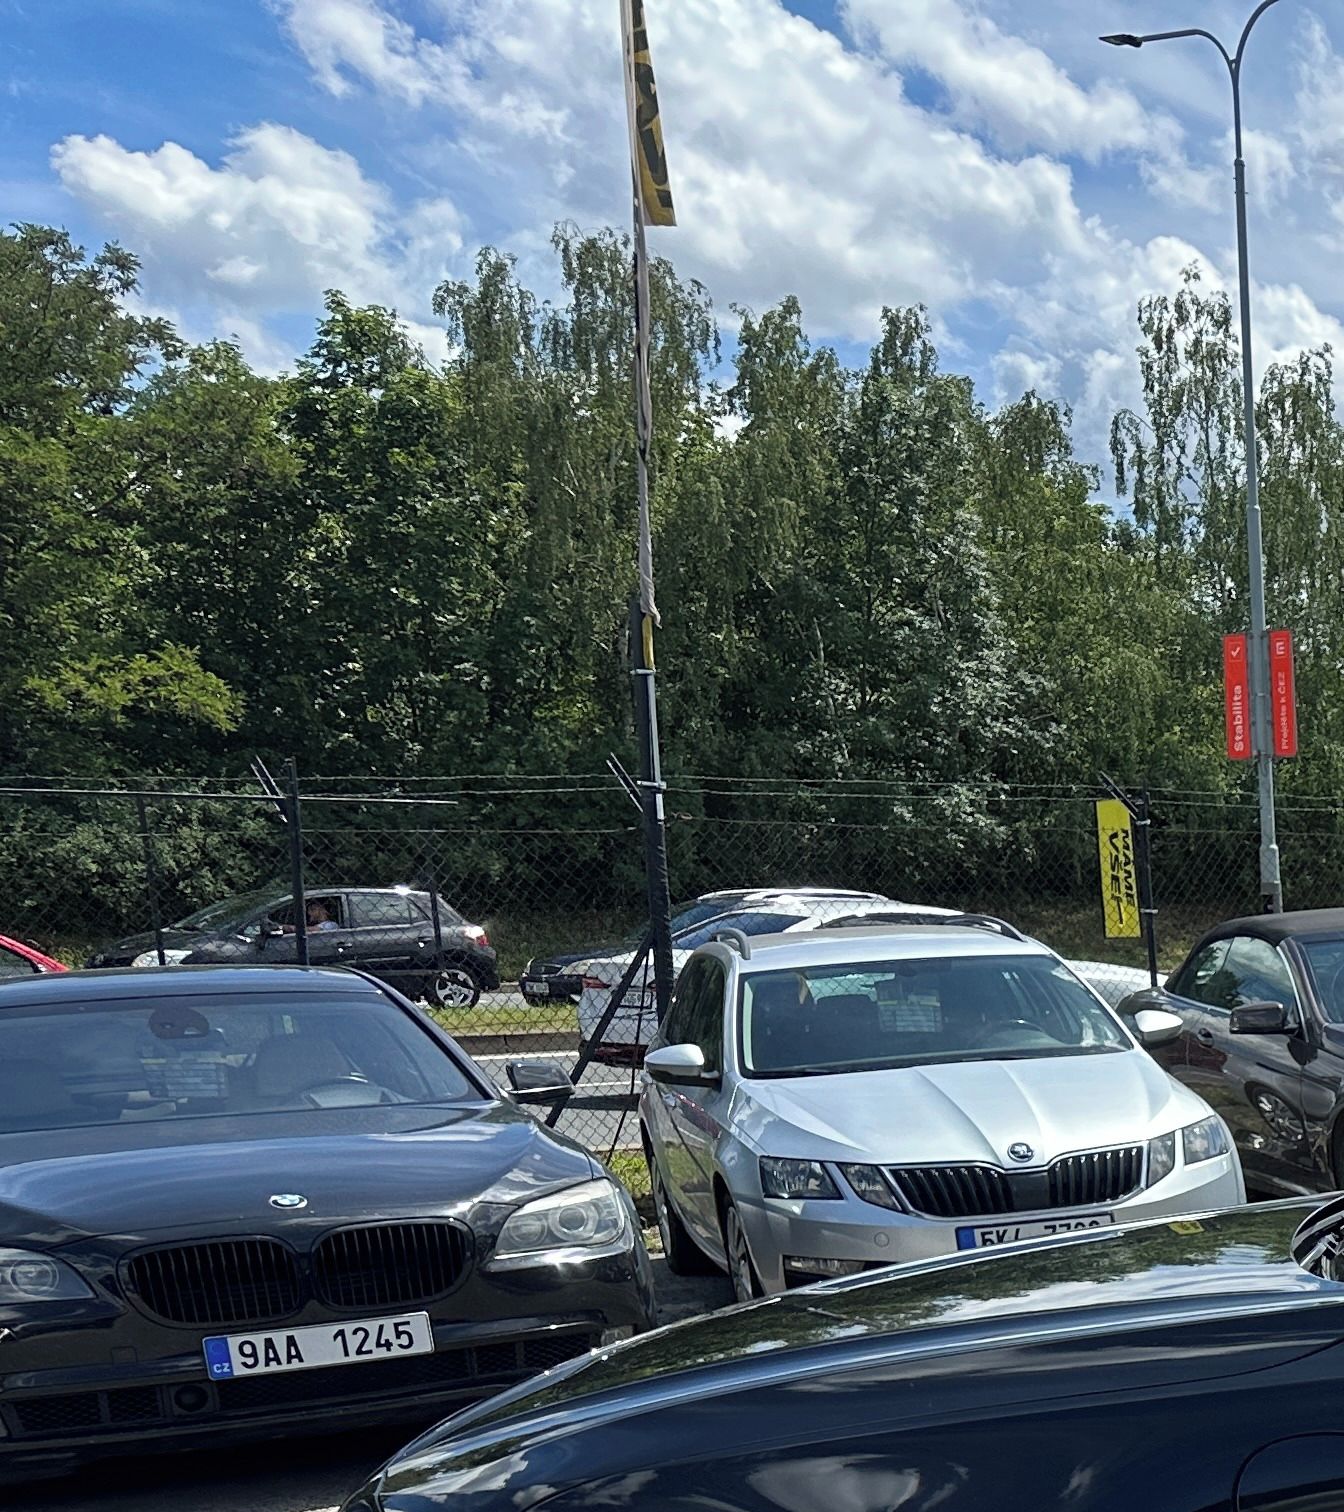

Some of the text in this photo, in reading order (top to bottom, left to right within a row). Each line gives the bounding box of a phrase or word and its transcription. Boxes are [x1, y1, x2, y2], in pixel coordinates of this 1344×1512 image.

[1232, 685, 1244, 752] Stabilita
[213, 1320, 414, 1373] CZ 9AA 1245
